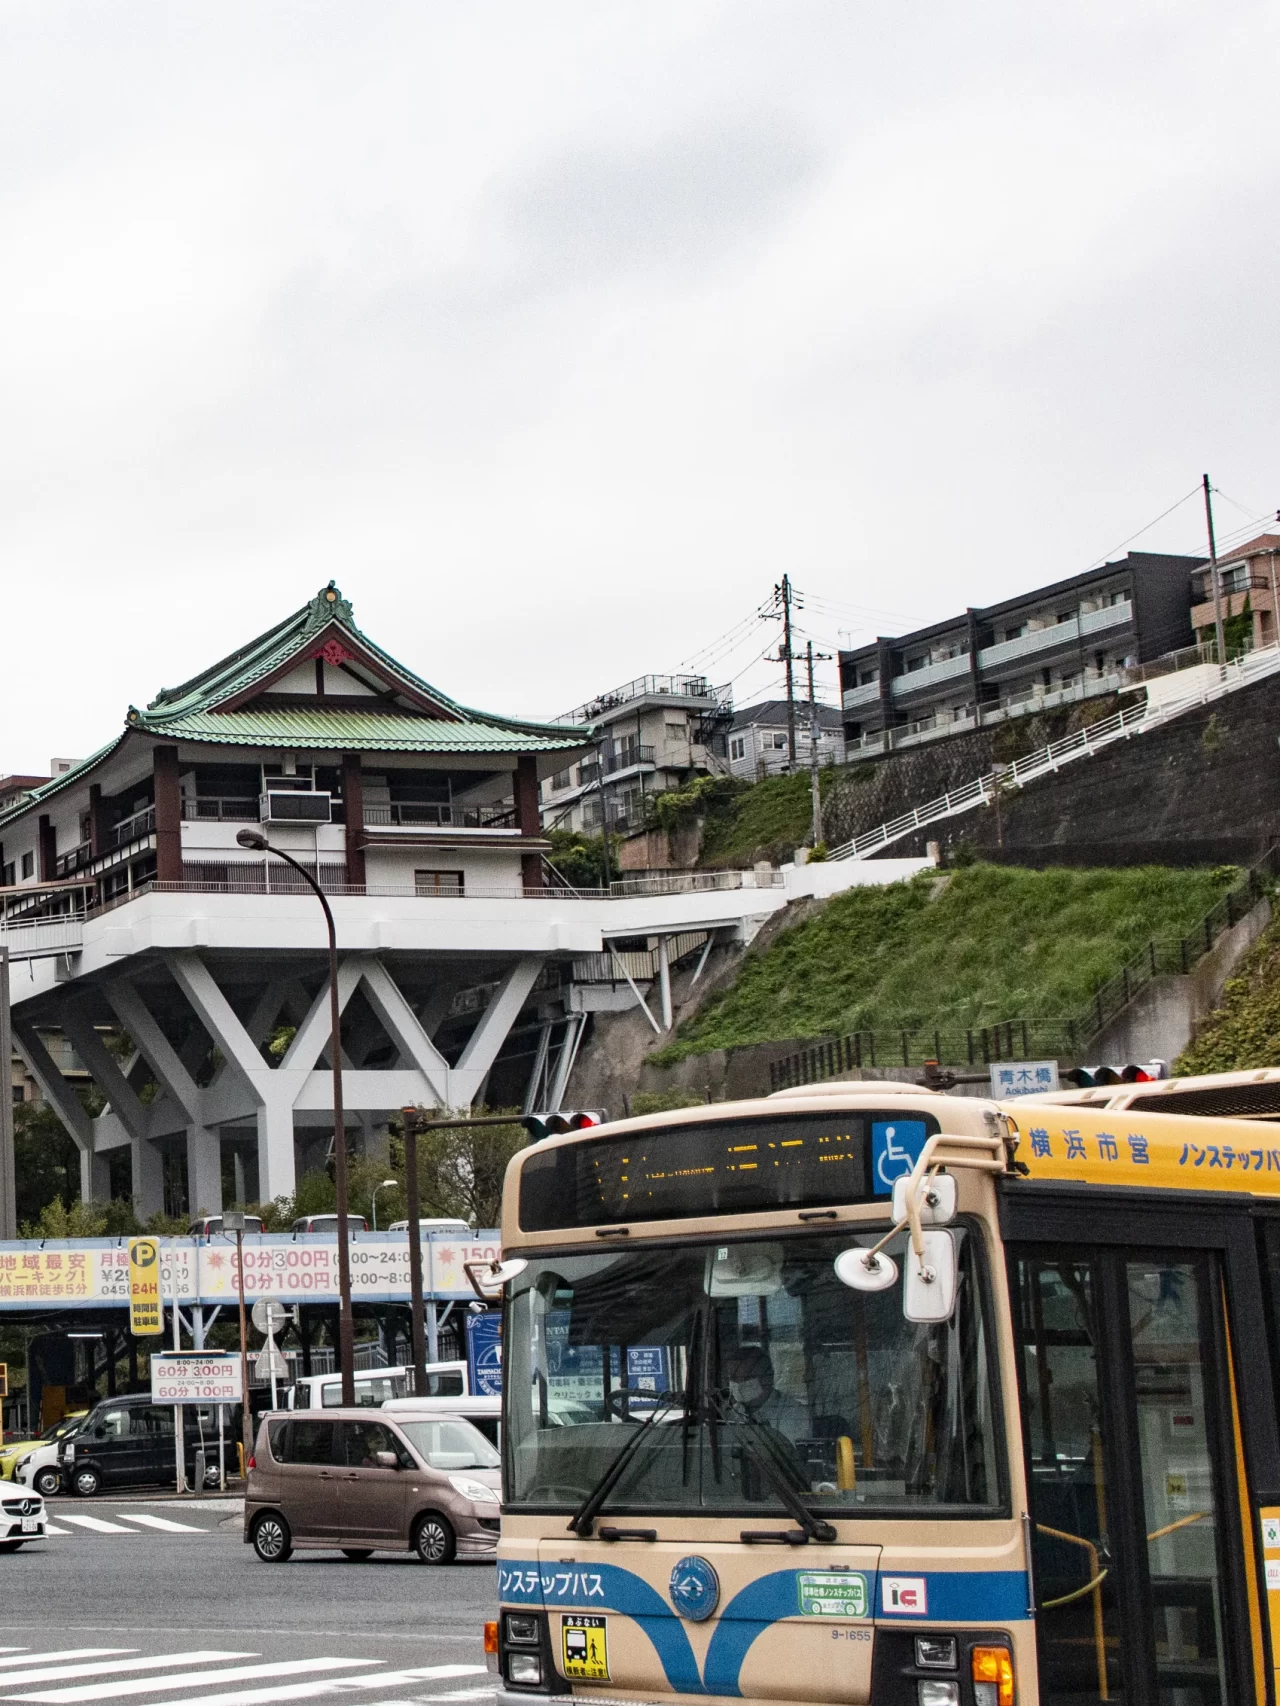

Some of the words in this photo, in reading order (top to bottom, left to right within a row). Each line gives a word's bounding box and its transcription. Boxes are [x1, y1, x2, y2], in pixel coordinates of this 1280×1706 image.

[998, 1066, 1051, 1085] 青木橋
[1005, 1086, 1048, 1096] Aokibashi
[1029, 1127, 1149, 1164] 横浜市営
[0, 1253, 86, 1270] 地域最安
[136, 1245, 154, 1265] P
[132, 1283, 158, 1295] 24H
[231, 1272, 329, 1290] 60分100円
[0, 1284, 87, 1296] 横浜駅徒歩5分
[497, 1569, 604, 1596] ノンステップバス
[566, 1617, 600, 1627] あぶない
[832, 1630, 870, 1641] 9-1655
